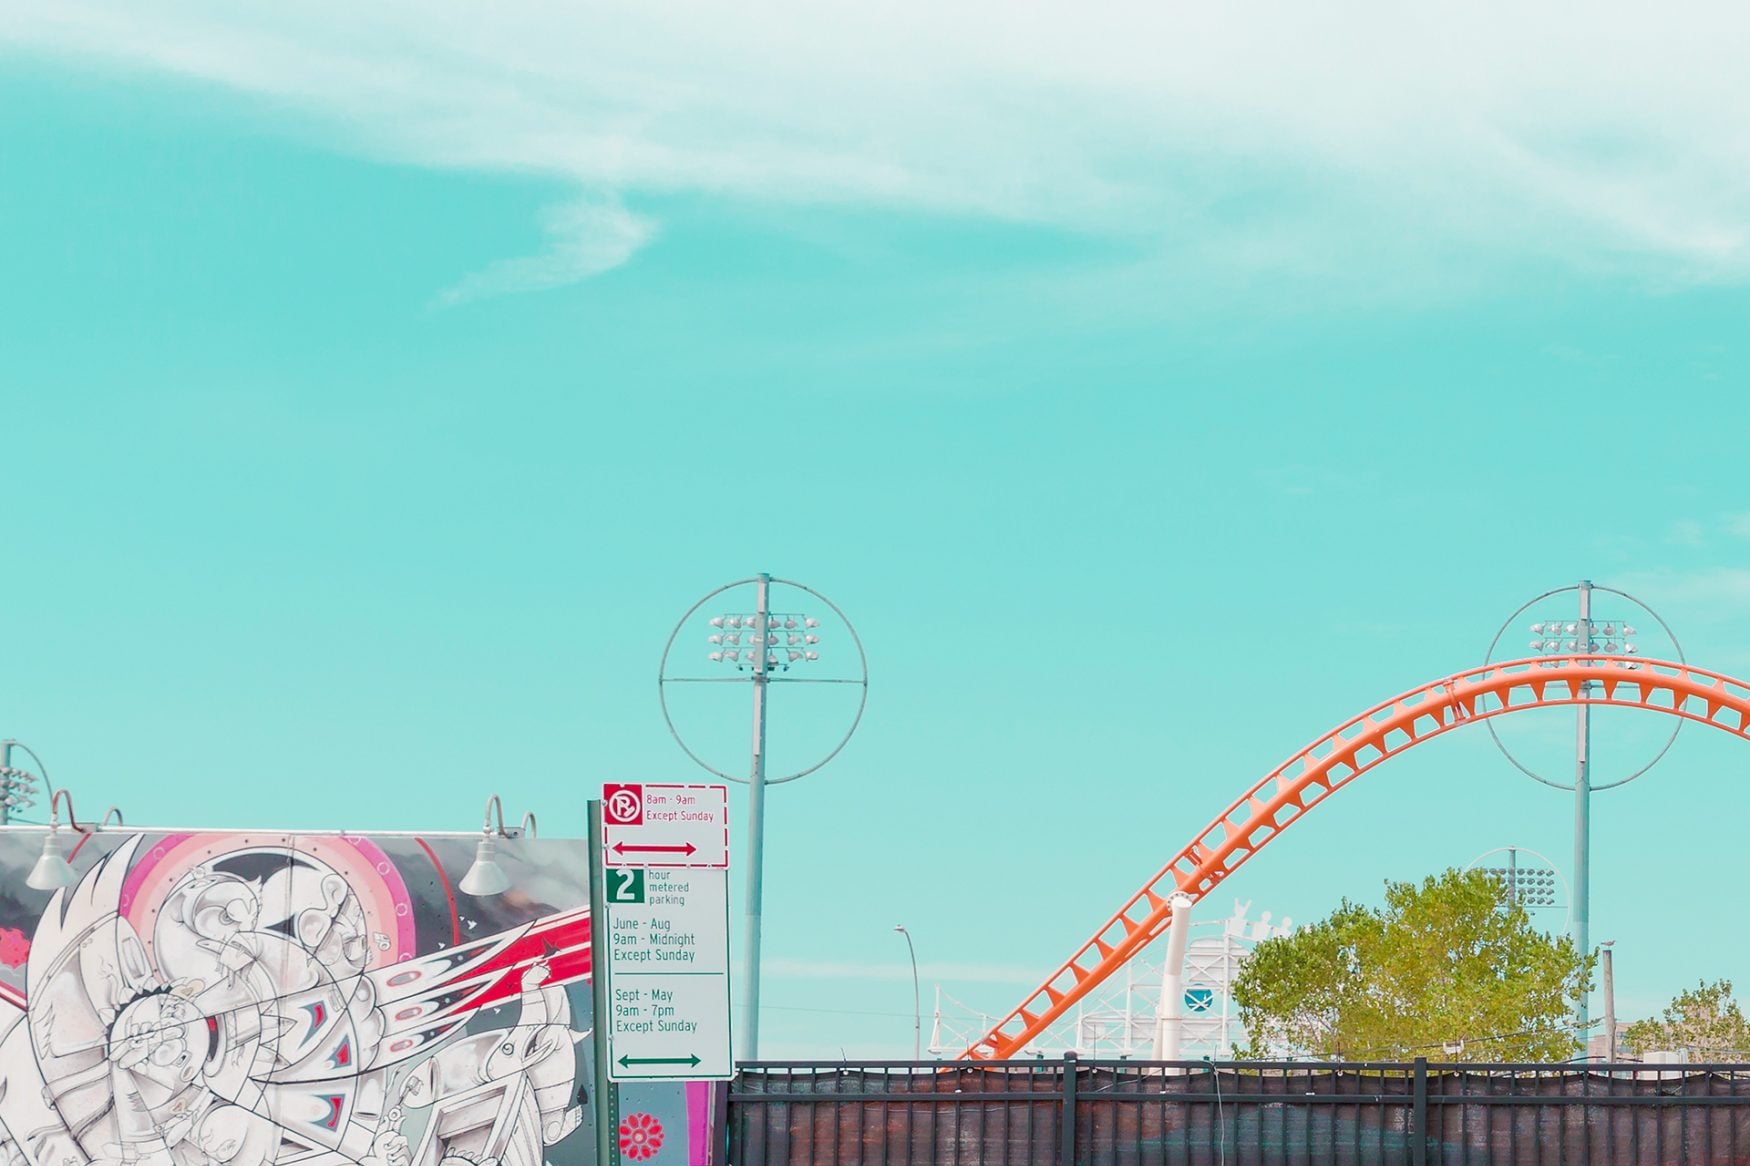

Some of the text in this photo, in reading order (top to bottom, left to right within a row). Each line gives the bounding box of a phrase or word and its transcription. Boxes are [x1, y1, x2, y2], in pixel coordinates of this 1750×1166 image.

[646, 795, 667, 805] 8am
[676, 795, 696, 805] 9am
[646, 811, 714, 823] Except Sunday
[649, 870, 671, 880] hour
[616, 869, 636, 901] 2
[649, 880, 689, 892] metered
[649, 895, 685, 906] parking
[613, 918, 639, 930] June
[650, 918, 671, 932] Aug
[613, 934, 637, 945] 9am
[650, 933, 695, 948] Midnight
[614, 949, 695, 962] Except Sunday
[616, 989, 640, 1003] Sept
[652, 989, 673, 1003] May
[616, 1005, 639, 1017] 9am
[652, 1005, 674, 1018] 7pm
[616, 1020, 698, 1034] Except Sunday
